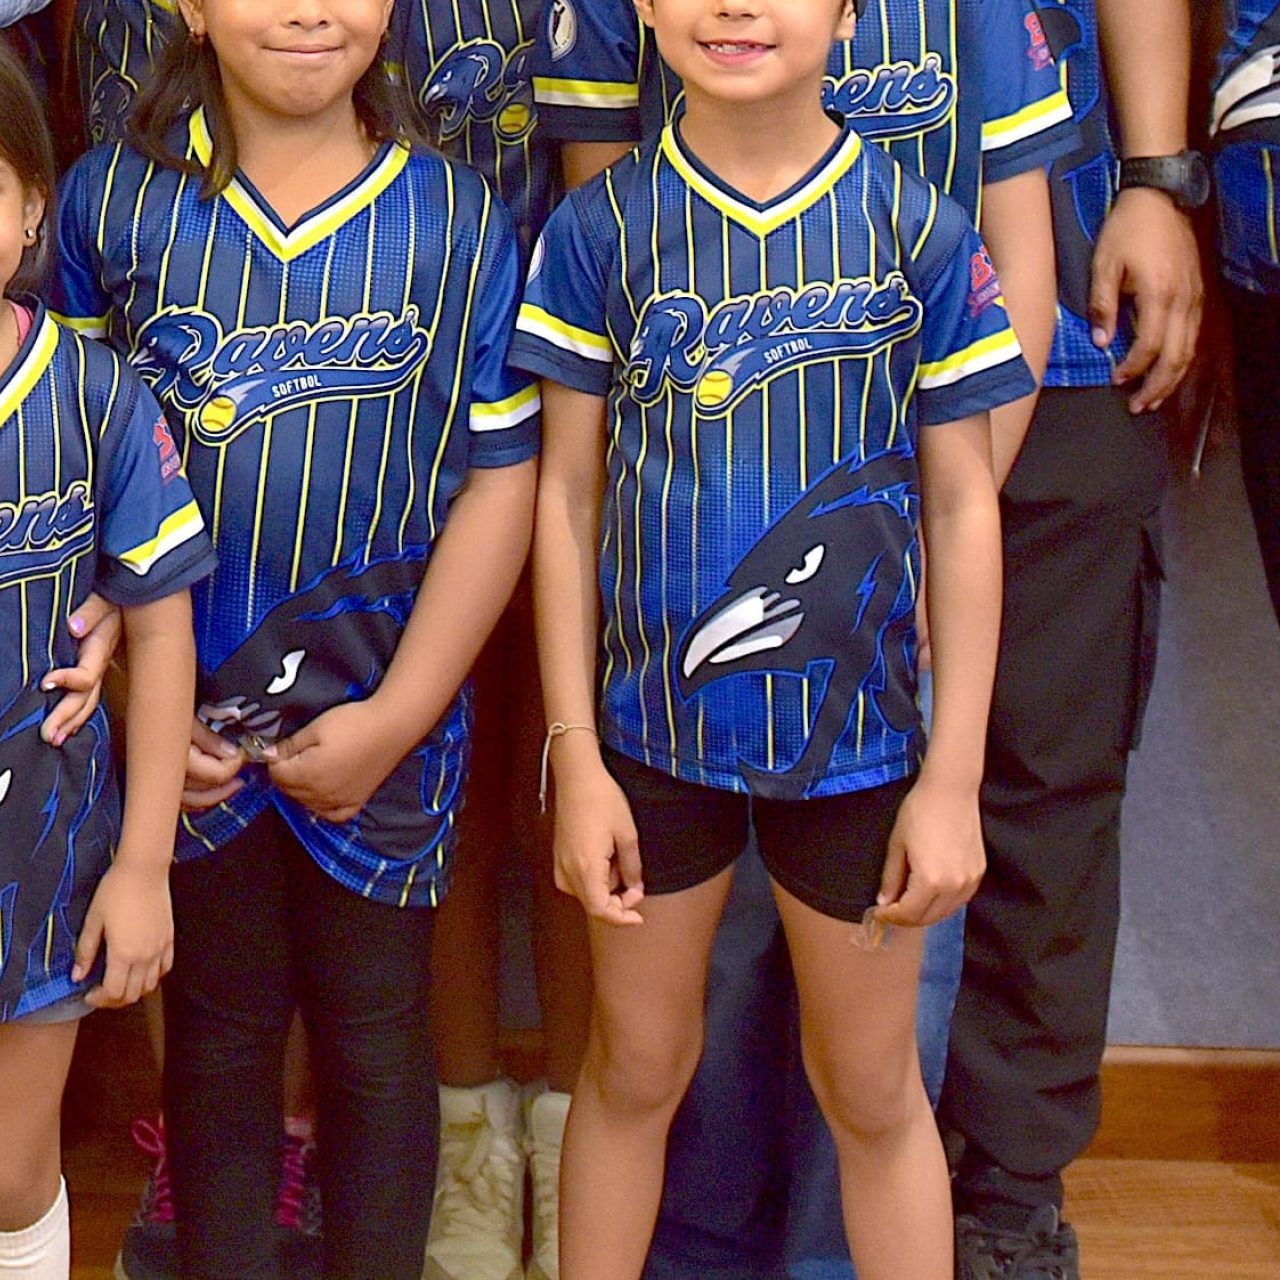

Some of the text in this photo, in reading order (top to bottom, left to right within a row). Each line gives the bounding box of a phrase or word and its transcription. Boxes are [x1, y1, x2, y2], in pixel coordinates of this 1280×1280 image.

[821, 57, 953, 112] ens
[129, 308, 426, 404] Ravens
[627, 275, 920, 400] Ravens
[764, 337, 813, 365] SOFTBOL
[272, 374, 321, 398] SOFTBOL
